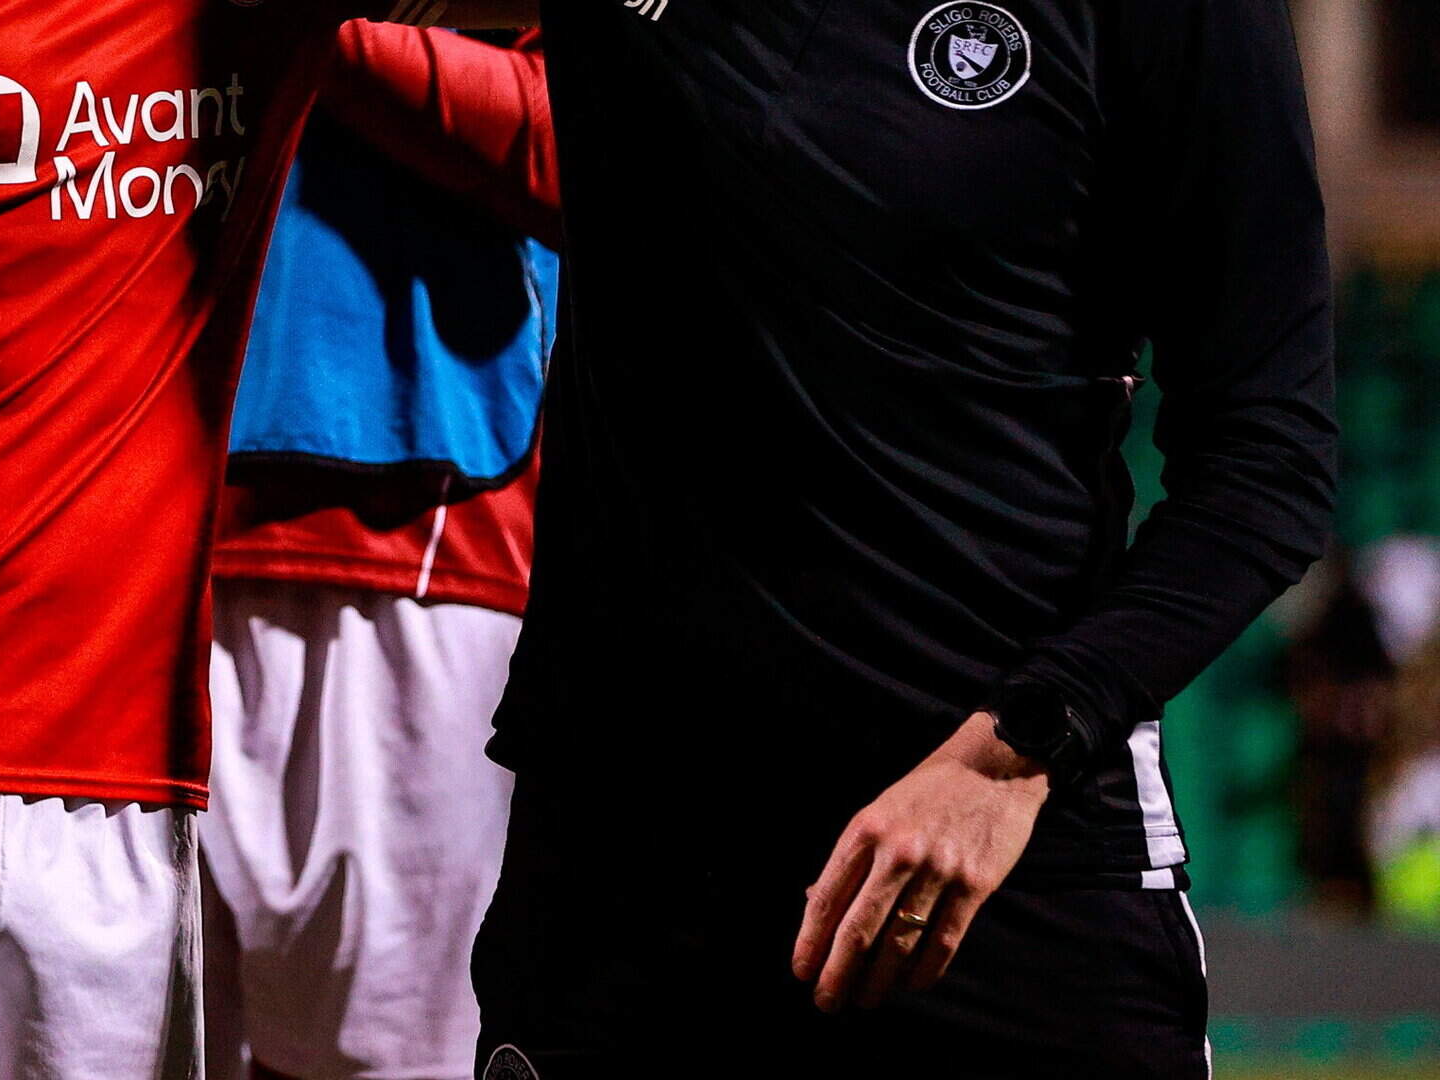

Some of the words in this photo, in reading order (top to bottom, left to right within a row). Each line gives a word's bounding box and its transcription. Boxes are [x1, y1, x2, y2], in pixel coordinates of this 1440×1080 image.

[929, 7, 973, 34] SLIGO
[978, 9, 1022, 52] ROVERS
[952, 39, 993, 57] SRFC
[920, 62, 974, 102] FOOTBALL
[976, 79, 1011, 101] CLUB
[56, 73, 245, 151] Avant
